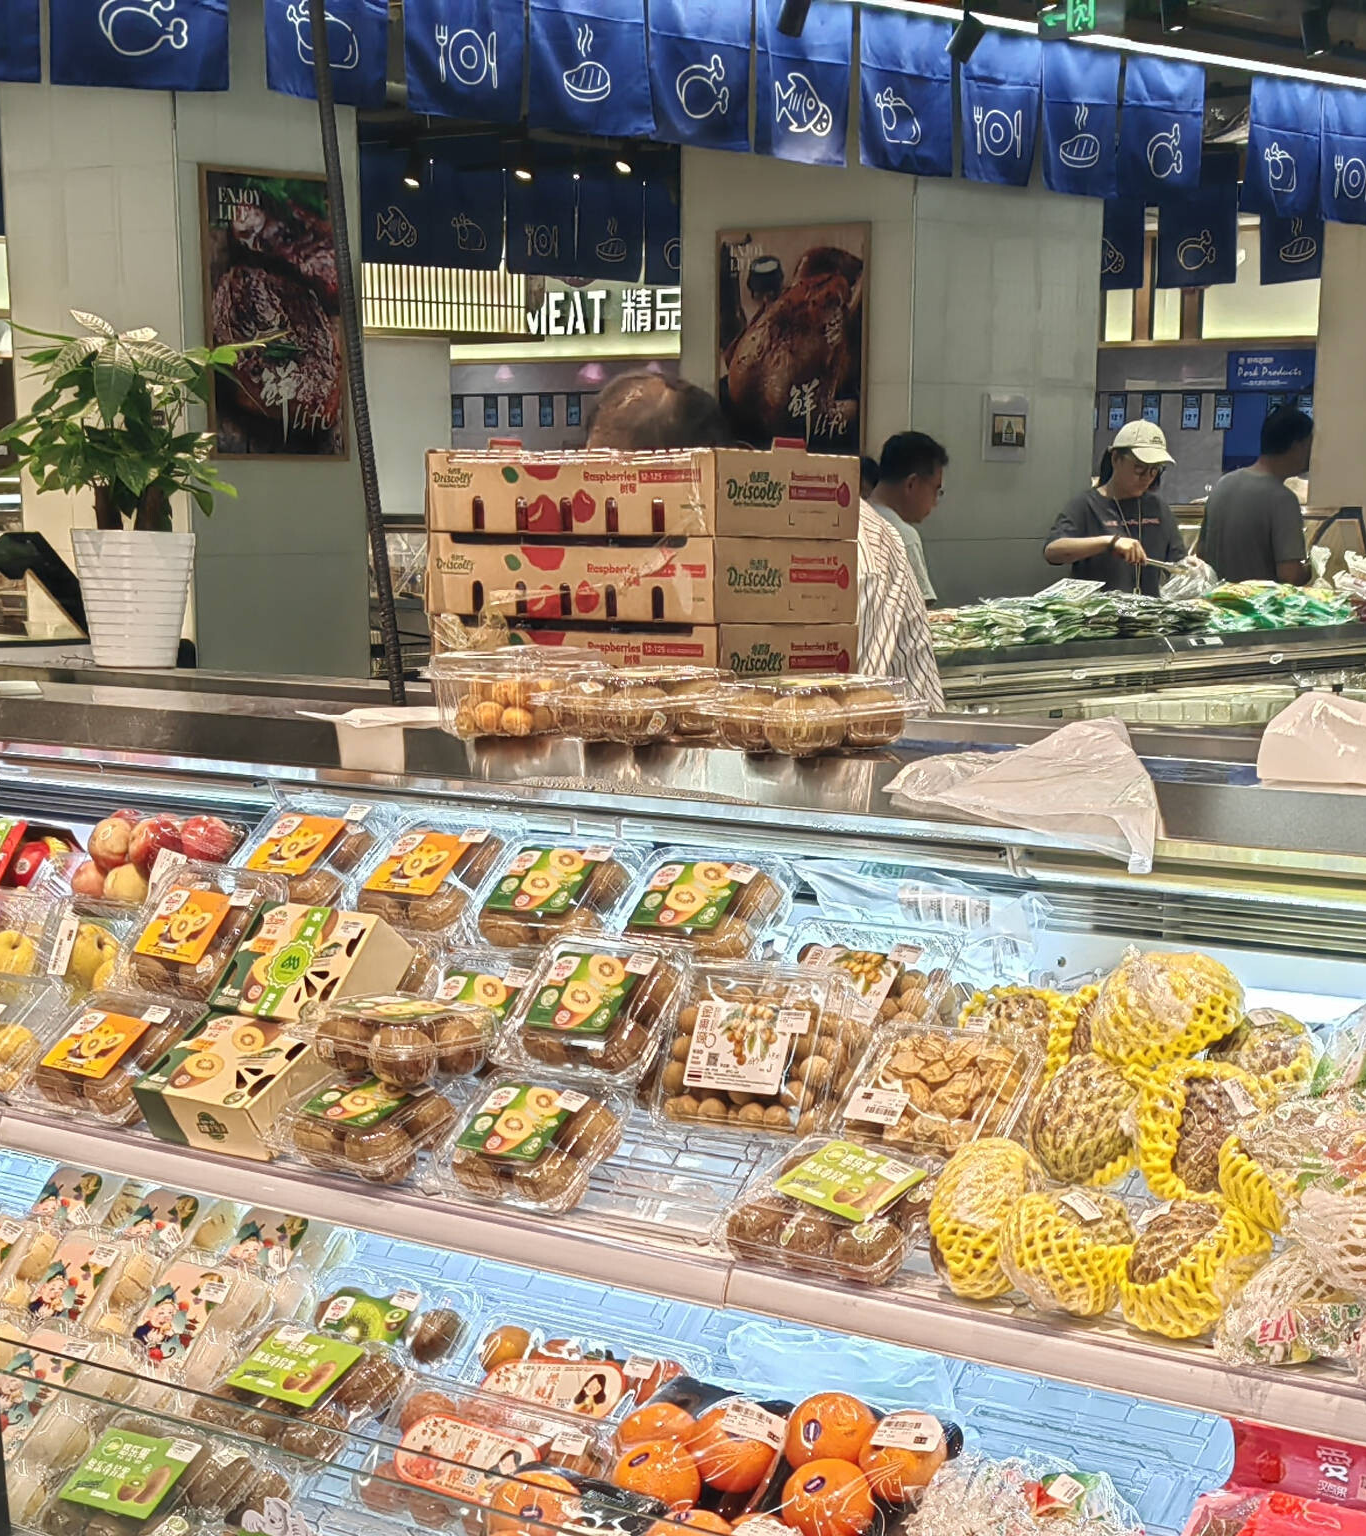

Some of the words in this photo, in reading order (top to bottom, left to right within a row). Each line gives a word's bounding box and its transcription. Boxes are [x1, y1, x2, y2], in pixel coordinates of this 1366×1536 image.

[620, 287, 682, 333] 精品
[292, 402, 333, 438] life
[787, 377, 820, 450] 鲜
[582, 470, 637, 485] Raspberries
[726, 478, 787, 502] Driscoll's
[726, 565, 784, 588] Driscoll's
